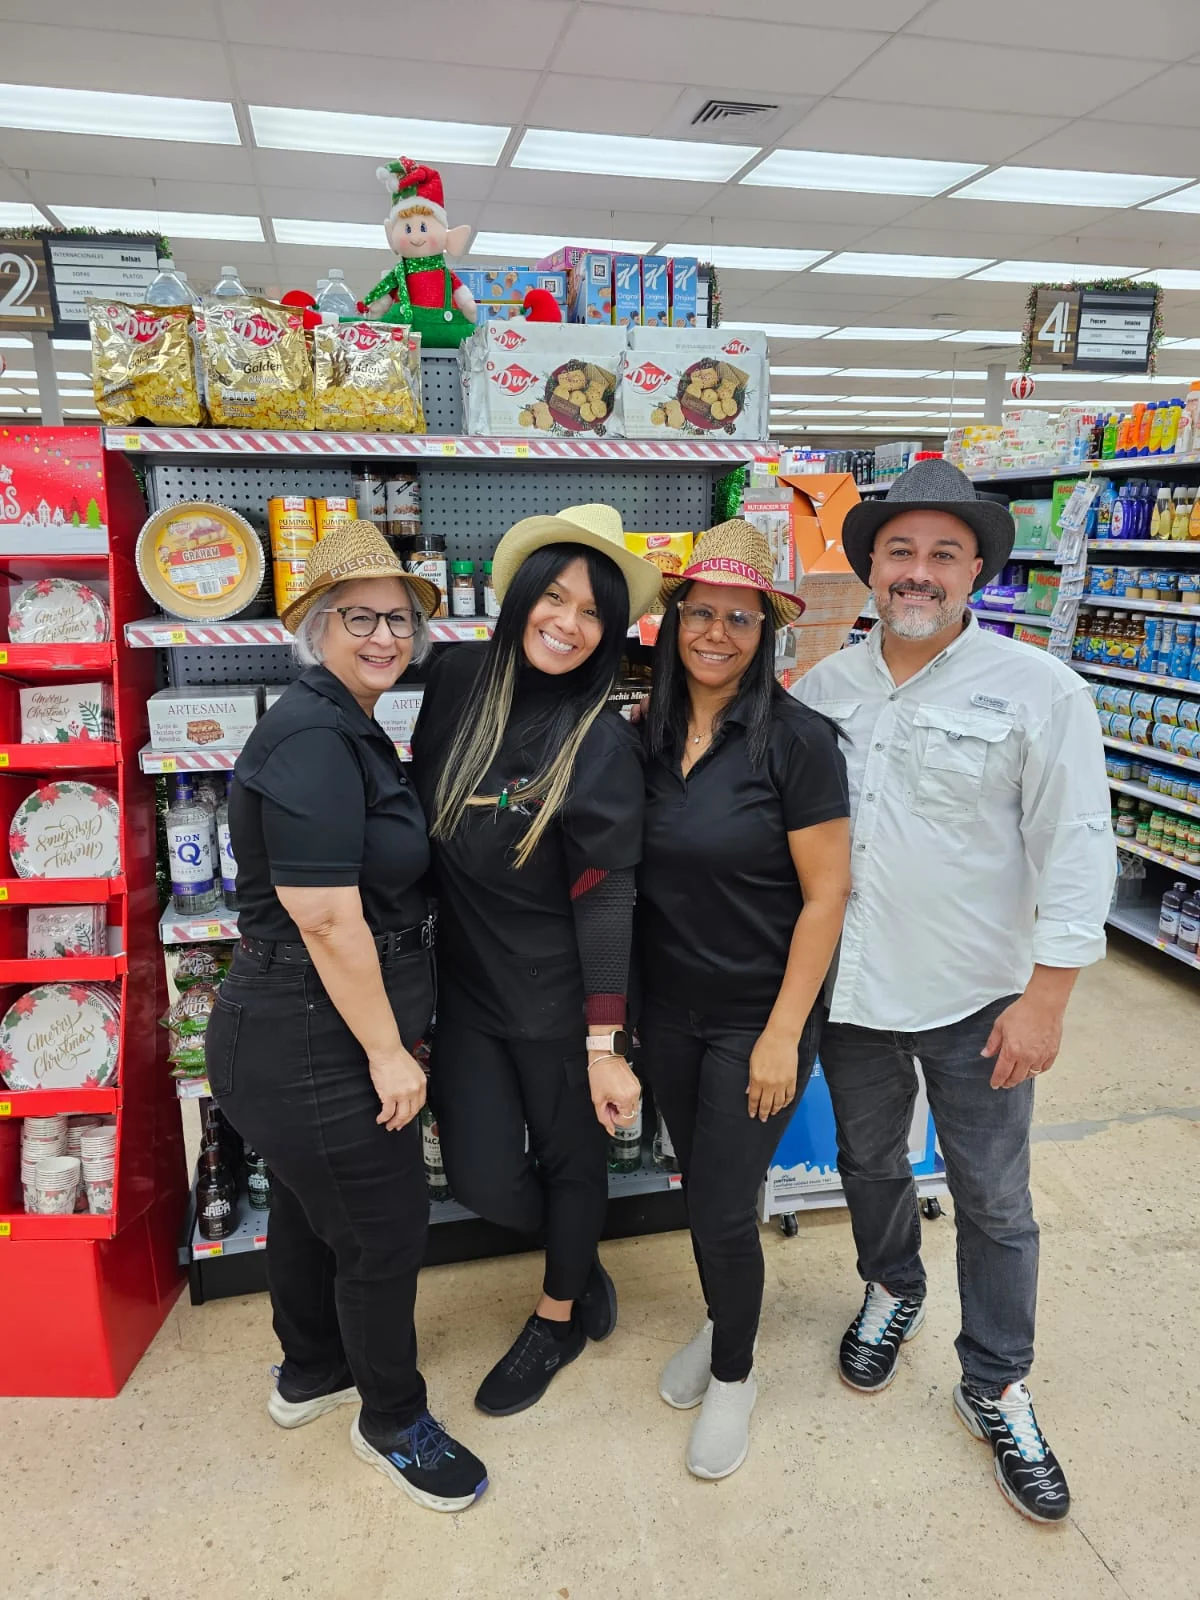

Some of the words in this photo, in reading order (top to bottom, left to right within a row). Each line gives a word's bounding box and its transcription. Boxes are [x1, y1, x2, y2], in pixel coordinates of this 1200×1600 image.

[52, 252, 104, 260] INTERNACIONALES
[0, 252, 38, 317] 2
[616, 264, 639, 290] K
[644, 265, 666, 291] K
[674, 264, 697, 292] K
[120, 319, 170, 339] Dux
[233, 318, 285, 341] Dux
[340, 326, 391, 350] Dux
[1038, 302, 1070, 353] 4
[498, 333, 525, 347] Dux
[242, 361, 282, 375] Golden
[498, 370, 537, 388] Dux
[632, 366, 669, 387] Dux
[182, 545, 220, 562] GRAHAM
[329, 554, 387, 579] PUERTO
[701, 559, 755, 581] PUERTO
[34, 606, 83, 624] Merry
[33, 620, 89, 643] Christmas
[31, 692, 70, 705] Merry
[26, 705, 71, 722] Christmas
[36, 814, 104, 852] Christmas
[175, 833, 200, 843] DON
[43, 842, 104, 869] Merry
[177, 842, 202, 866] Q
[26, 1011, 82, 1053] Merry
[33, 1023, 95, 1080] Christmas
